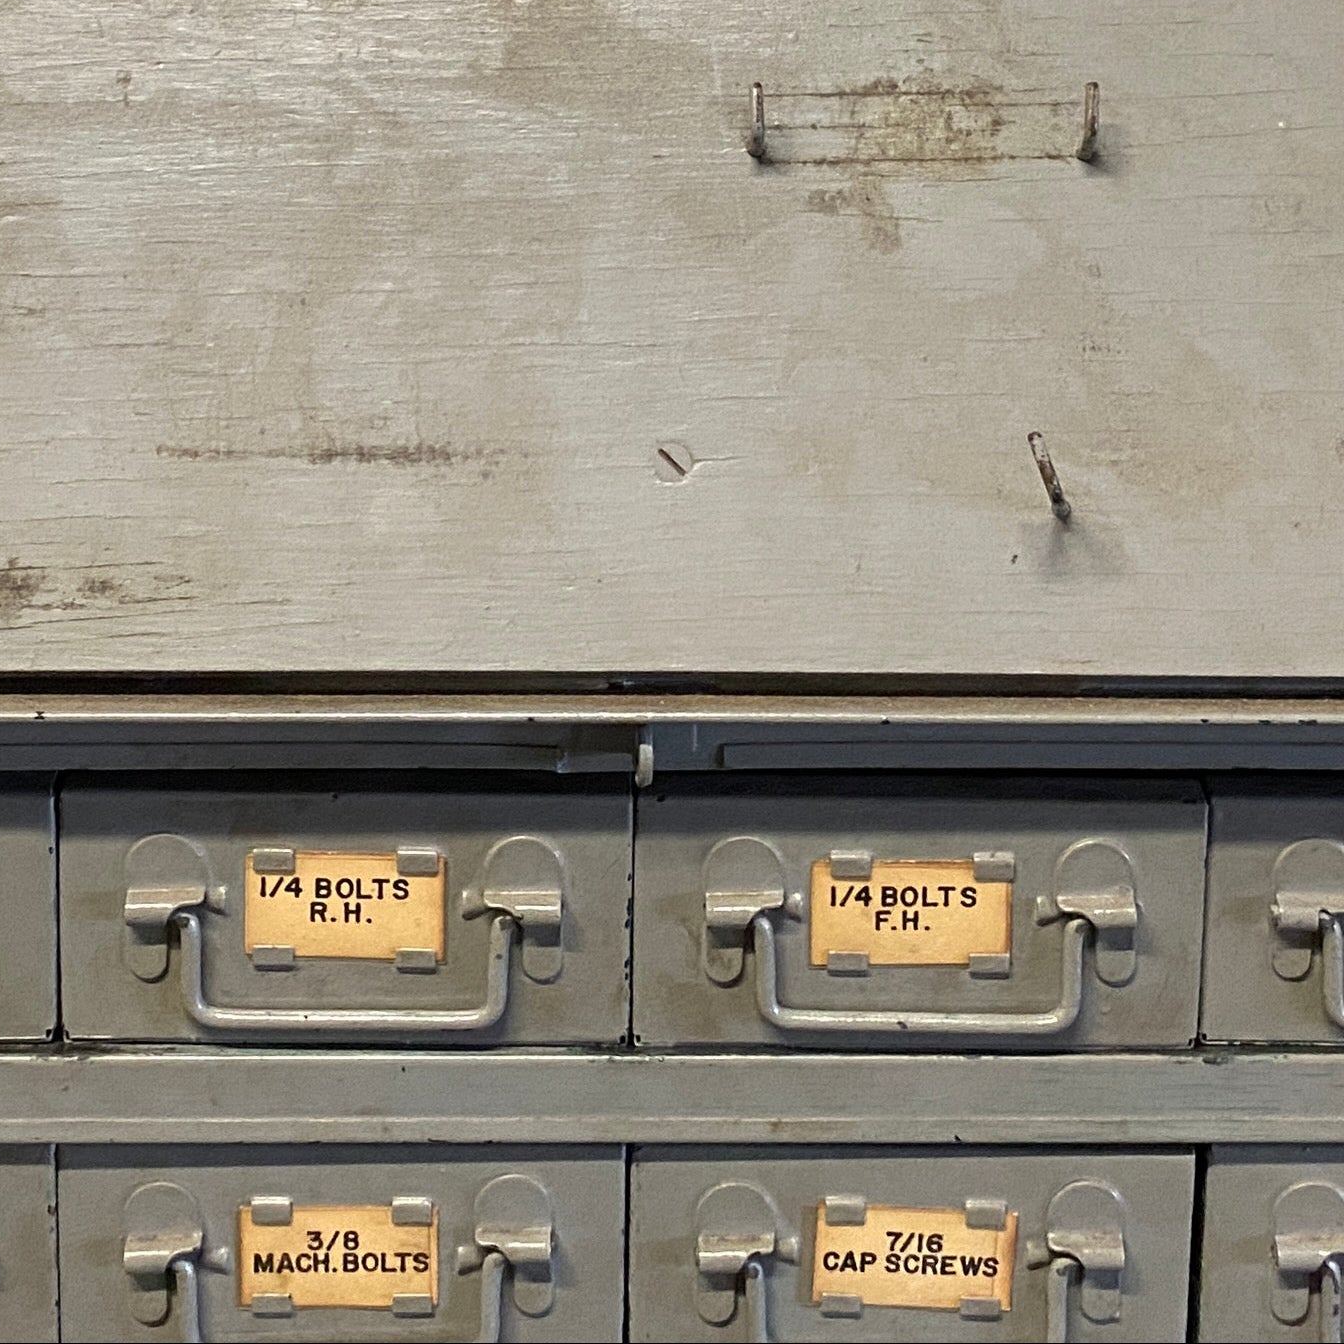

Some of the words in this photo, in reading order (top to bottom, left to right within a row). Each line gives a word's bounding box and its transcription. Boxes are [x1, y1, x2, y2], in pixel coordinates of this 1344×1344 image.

[259, 876, 303, 898] 1/4
[315, 877, 410, 900] BOLTS
[830, 885, 873, 907] 1/4
[881, 886, 978, 908] BOLTS
[309, 901, 373, 924] R.H.
[874, 910, 931, 931] F.H.
[306, 1230, 360, 1252] 3/8
[886, 1231, 944, 1253] 7/16
[823, 1251, 877, 1272] CAP
[885, 1254, 999, 1277] SCREWS
